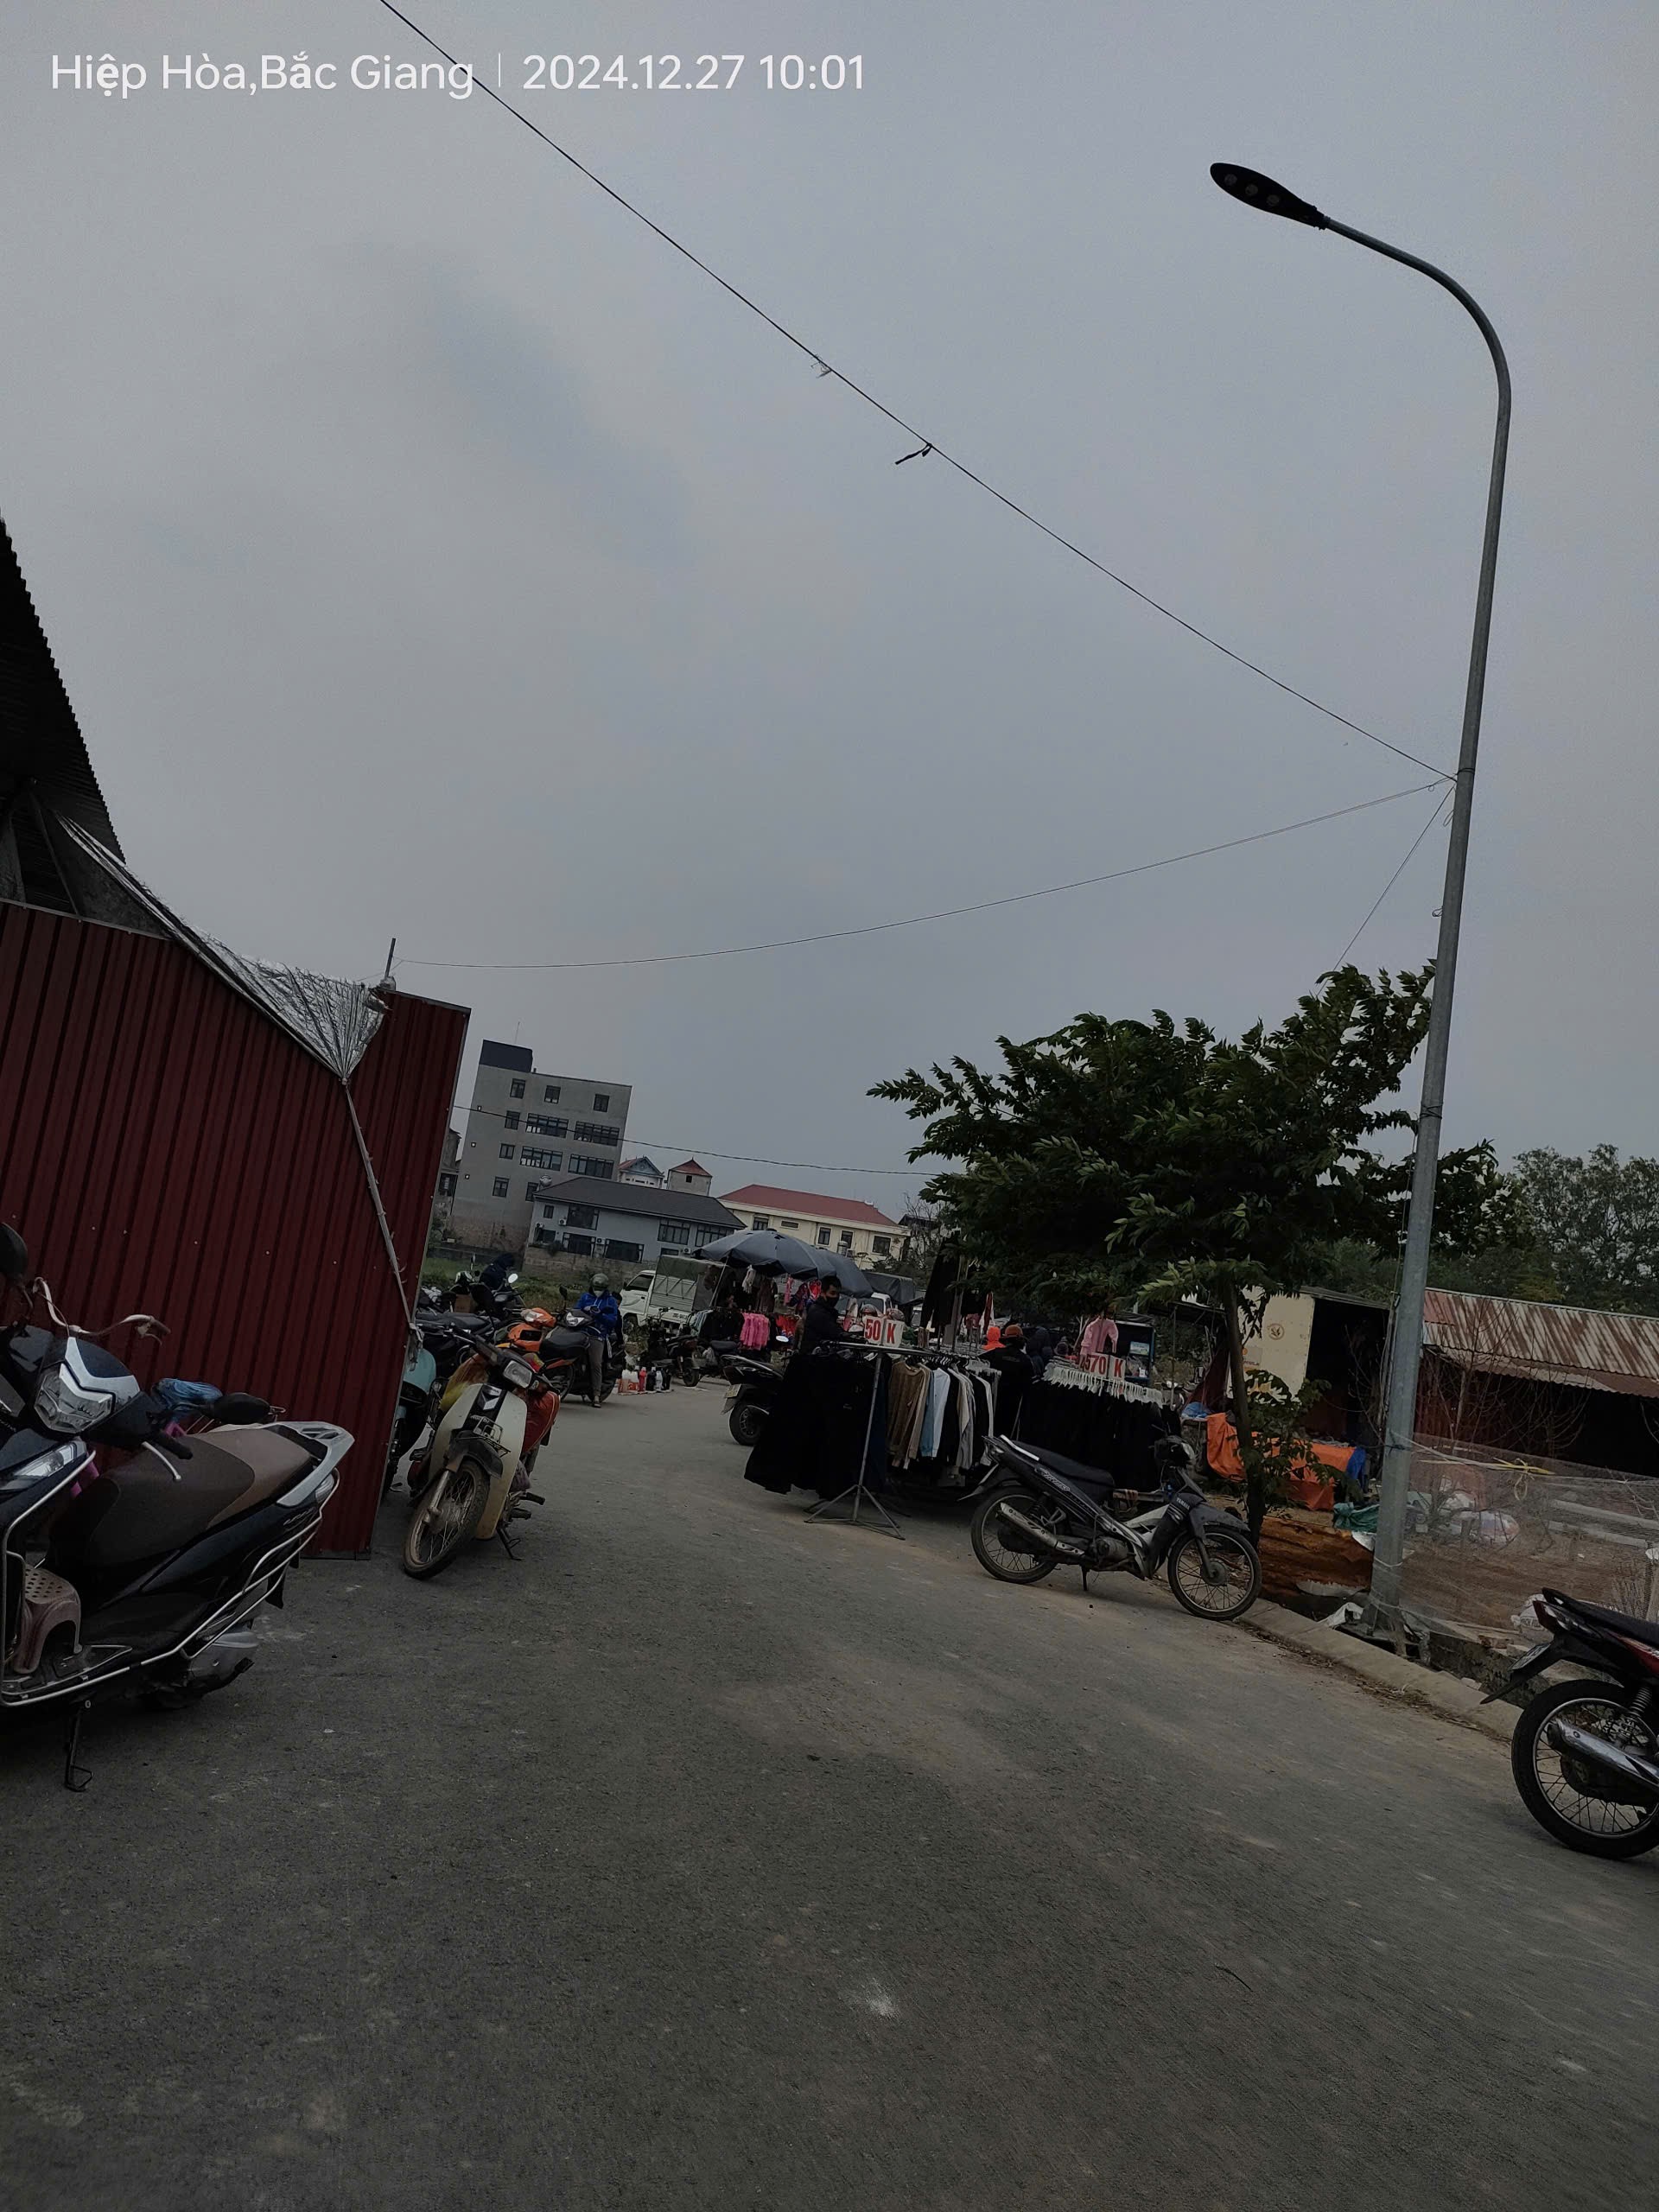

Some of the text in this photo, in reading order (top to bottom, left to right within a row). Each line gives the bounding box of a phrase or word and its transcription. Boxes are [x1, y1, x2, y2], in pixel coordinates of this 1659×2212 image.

[865, 1319, 897, 1344] 50 K
[1114, 1358, 1123, 1378] K
